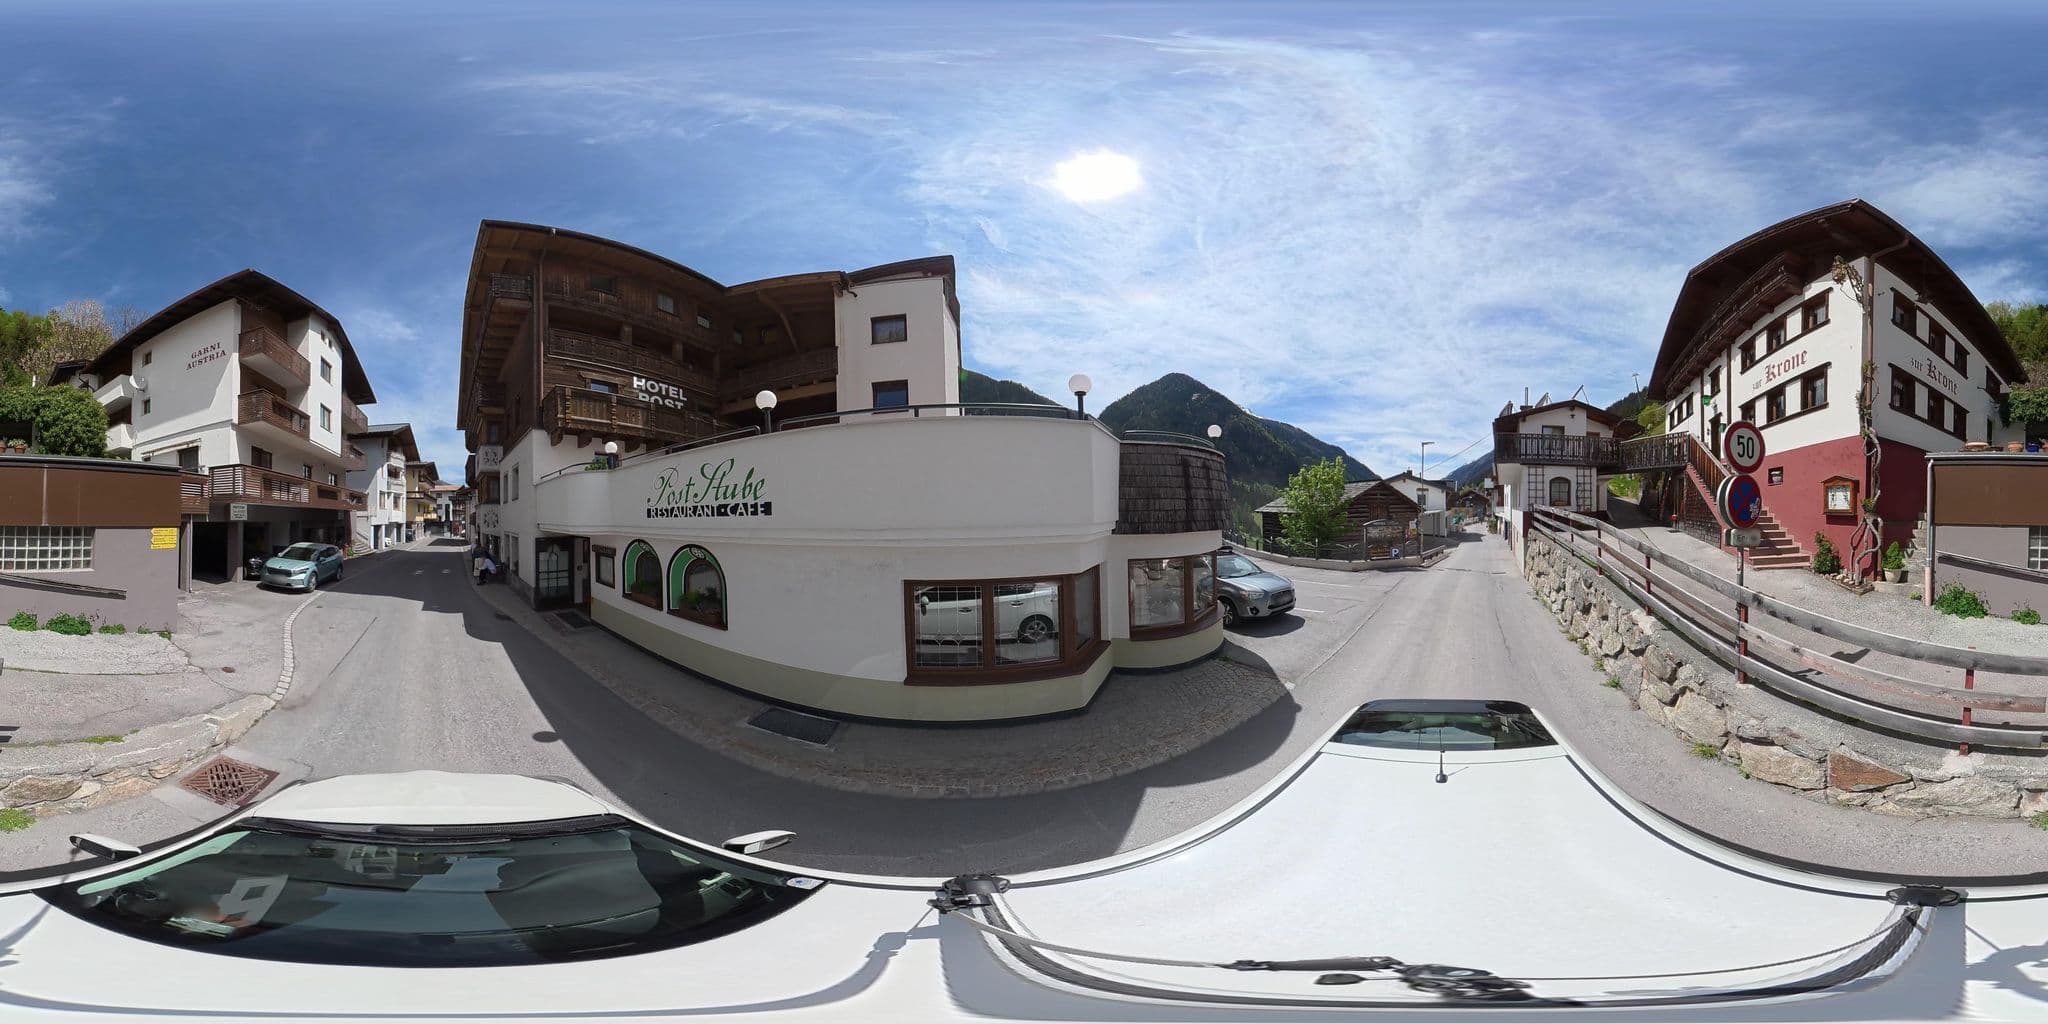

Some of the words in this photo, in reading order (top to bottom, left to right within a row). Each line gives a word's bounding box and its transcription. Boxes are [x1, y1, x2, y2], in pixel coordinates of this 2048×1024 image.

[186, 350, 226, 371] AUSTRIA
[191, 342, 221, 359] GARNI
[1764, 350, 1808, 385] Krone
[1910, 357, 1923, 371] zur
[1926, 357, 1958, 395] Krone
[633, 376, 687, 401] HOTEL
[1737, 434, 1755, 459] 50
[646, 464, 696, 507] Post
[693, 458, 768, 504] Stube
[650, 503, 717, 518] RESTAURANT
[1391, 548, 1400, 558] P
